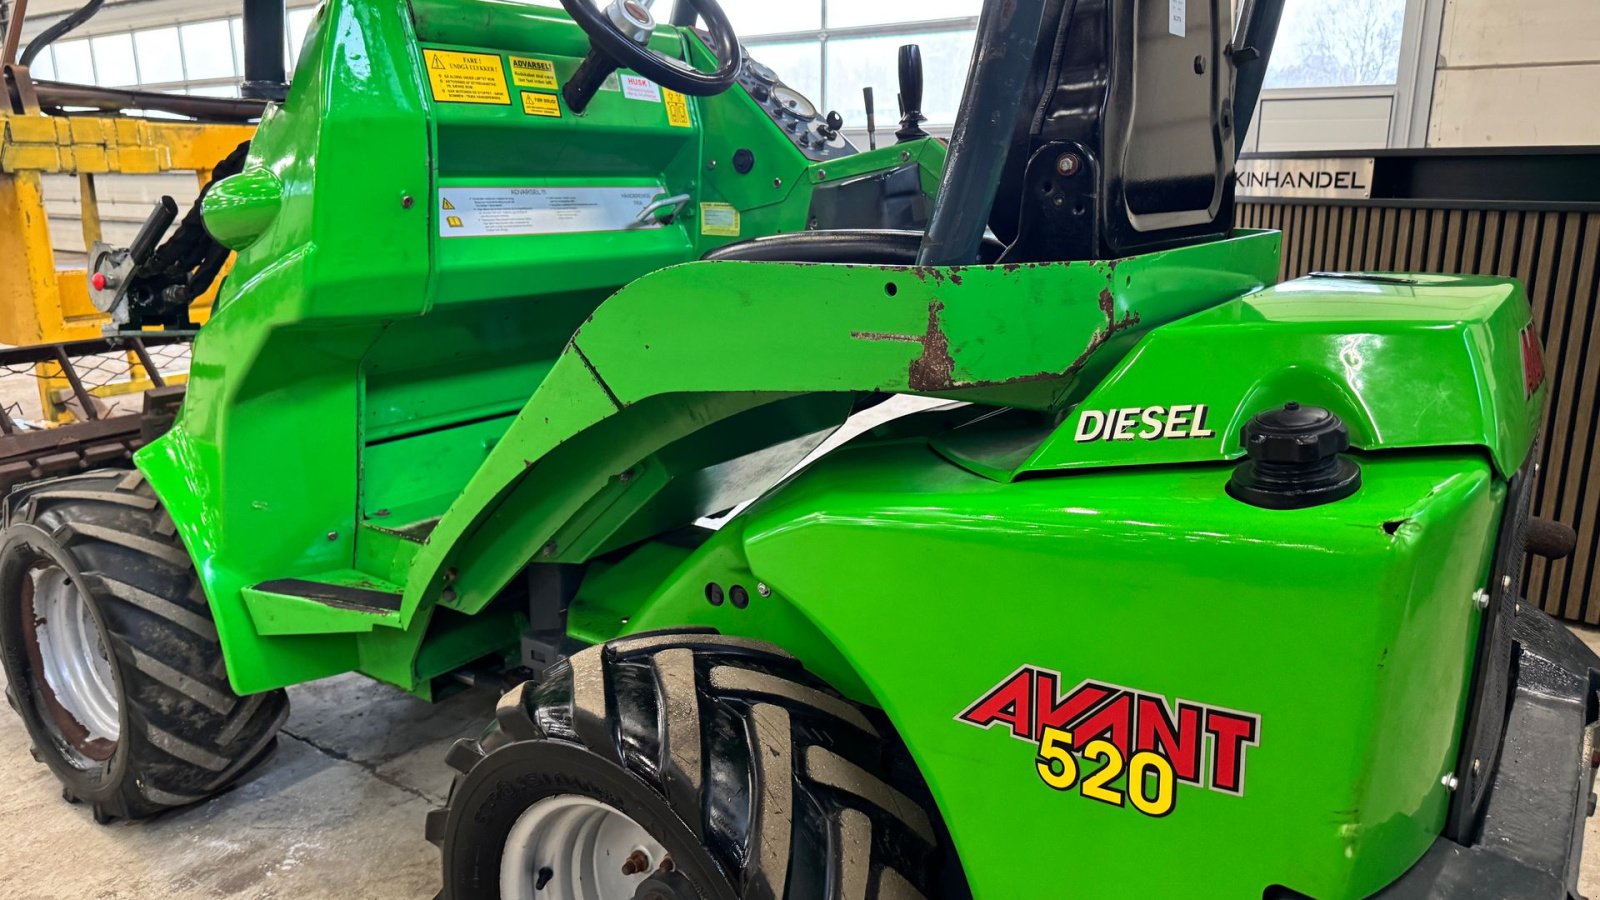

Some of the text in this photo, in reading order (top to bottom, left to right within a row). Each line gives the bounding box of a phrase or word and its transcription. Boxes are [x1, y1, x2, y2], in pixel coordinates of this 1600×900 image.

[513, 59, 552, 70] ADVARSEL!
[1073, 403, 1216, 443] DIESEL
[954, 664, 1260, 796] AVANT
[1035, 725, 1177, 818] 520
